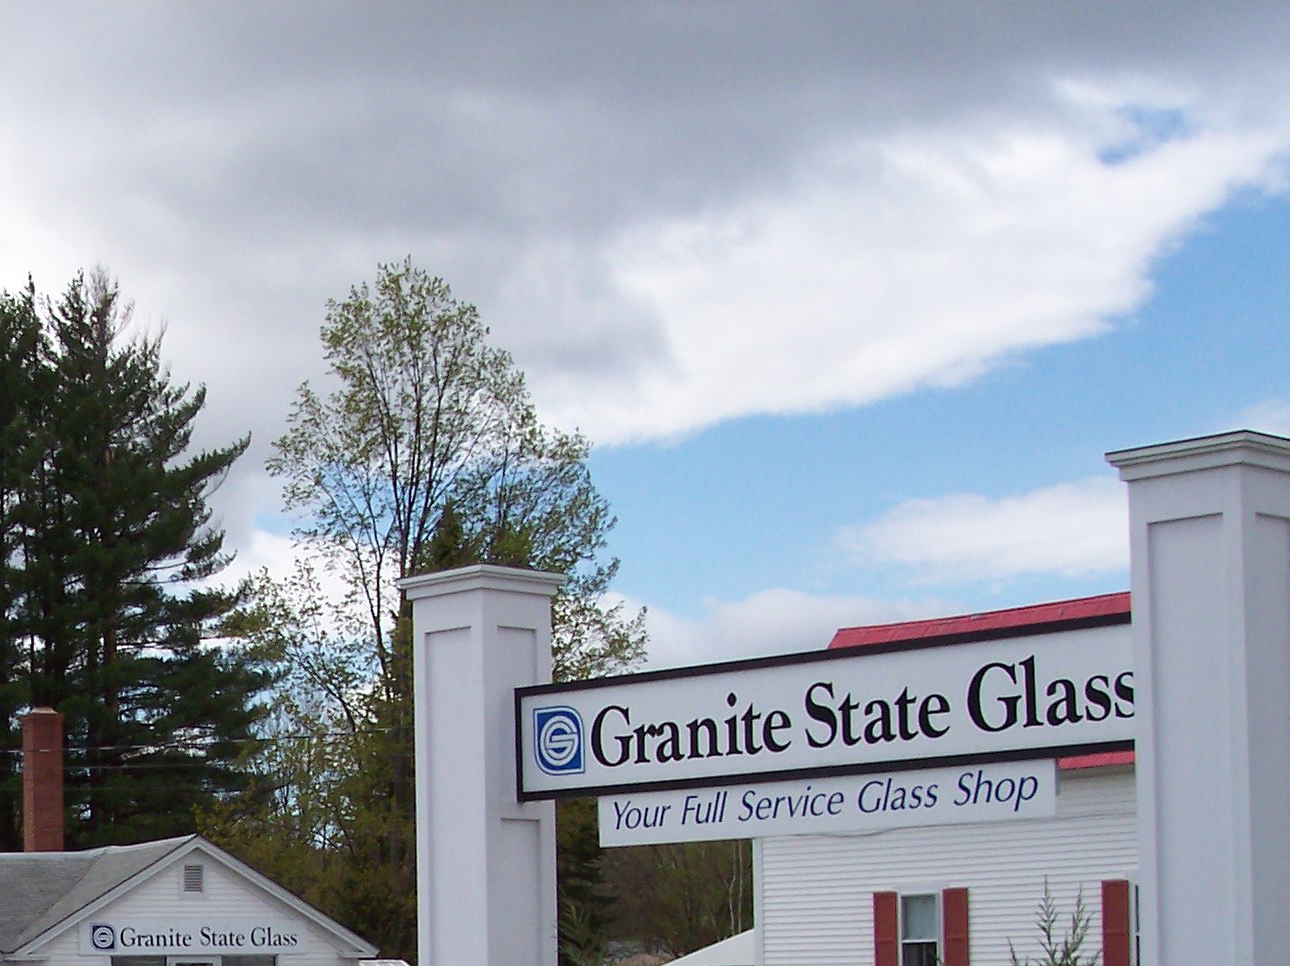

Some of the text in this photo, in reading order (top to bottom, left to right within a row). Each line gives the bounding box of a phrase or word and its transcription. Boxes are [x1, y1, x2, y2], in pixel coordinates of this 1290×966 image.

[590, 654, 1135, 768] Granite State Glass
[613, 769, 1039, 831] Your Full Service Glass Shop
[120, 926, 299, 948] Granite State Glass
